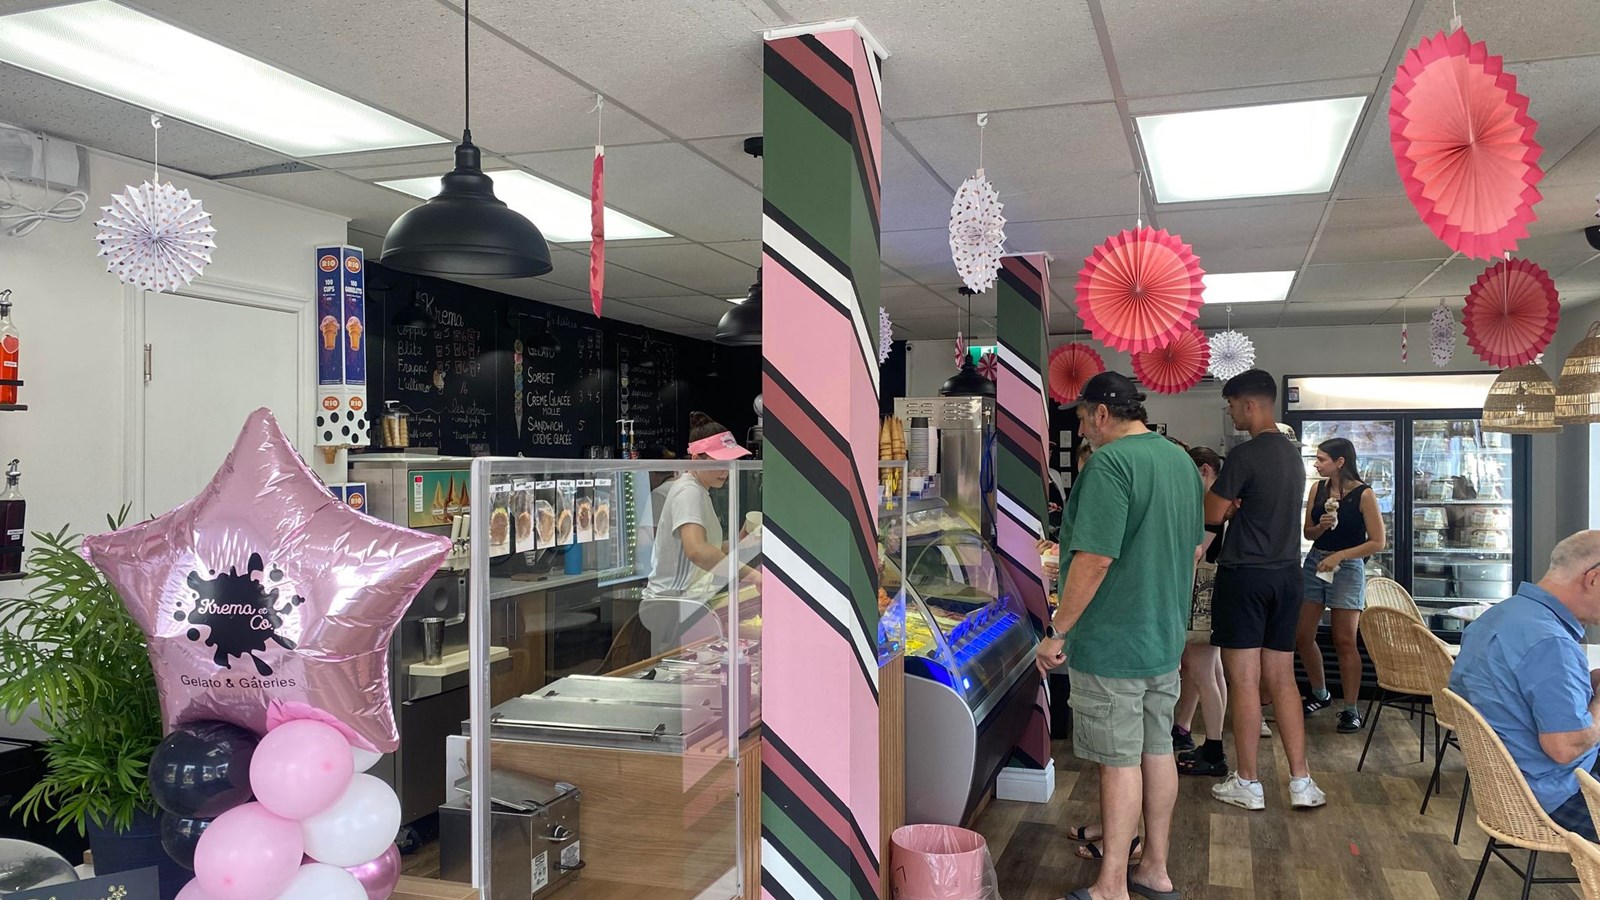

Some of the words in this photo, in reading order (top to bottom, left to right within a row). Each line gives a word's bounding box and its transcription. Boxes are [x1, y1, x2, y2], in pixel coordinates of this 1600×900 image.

[347, 260, 360, 268] RIO
[421, 291, 464, 327] Krema
[443, 328, 450, 338] 5
[397, 340, 423, 356] Blitz
[444, 344, 451, 356] 5
[444, 360, 451, 372] 5
[527, 366, 555, 384] SORBET
[542, 407, 561, 416] MOLLE
[527, 416, 564, 431] SANDWICH
[578, 420, 586, 432] 5
[198, 598, 257, 615] Krema
[250, 615, 275, 631] Co.
[180, 674, 222, 689] Gelato
[225, 678, 235, 689] &
[239, 675, 296, 689] Gâteries
